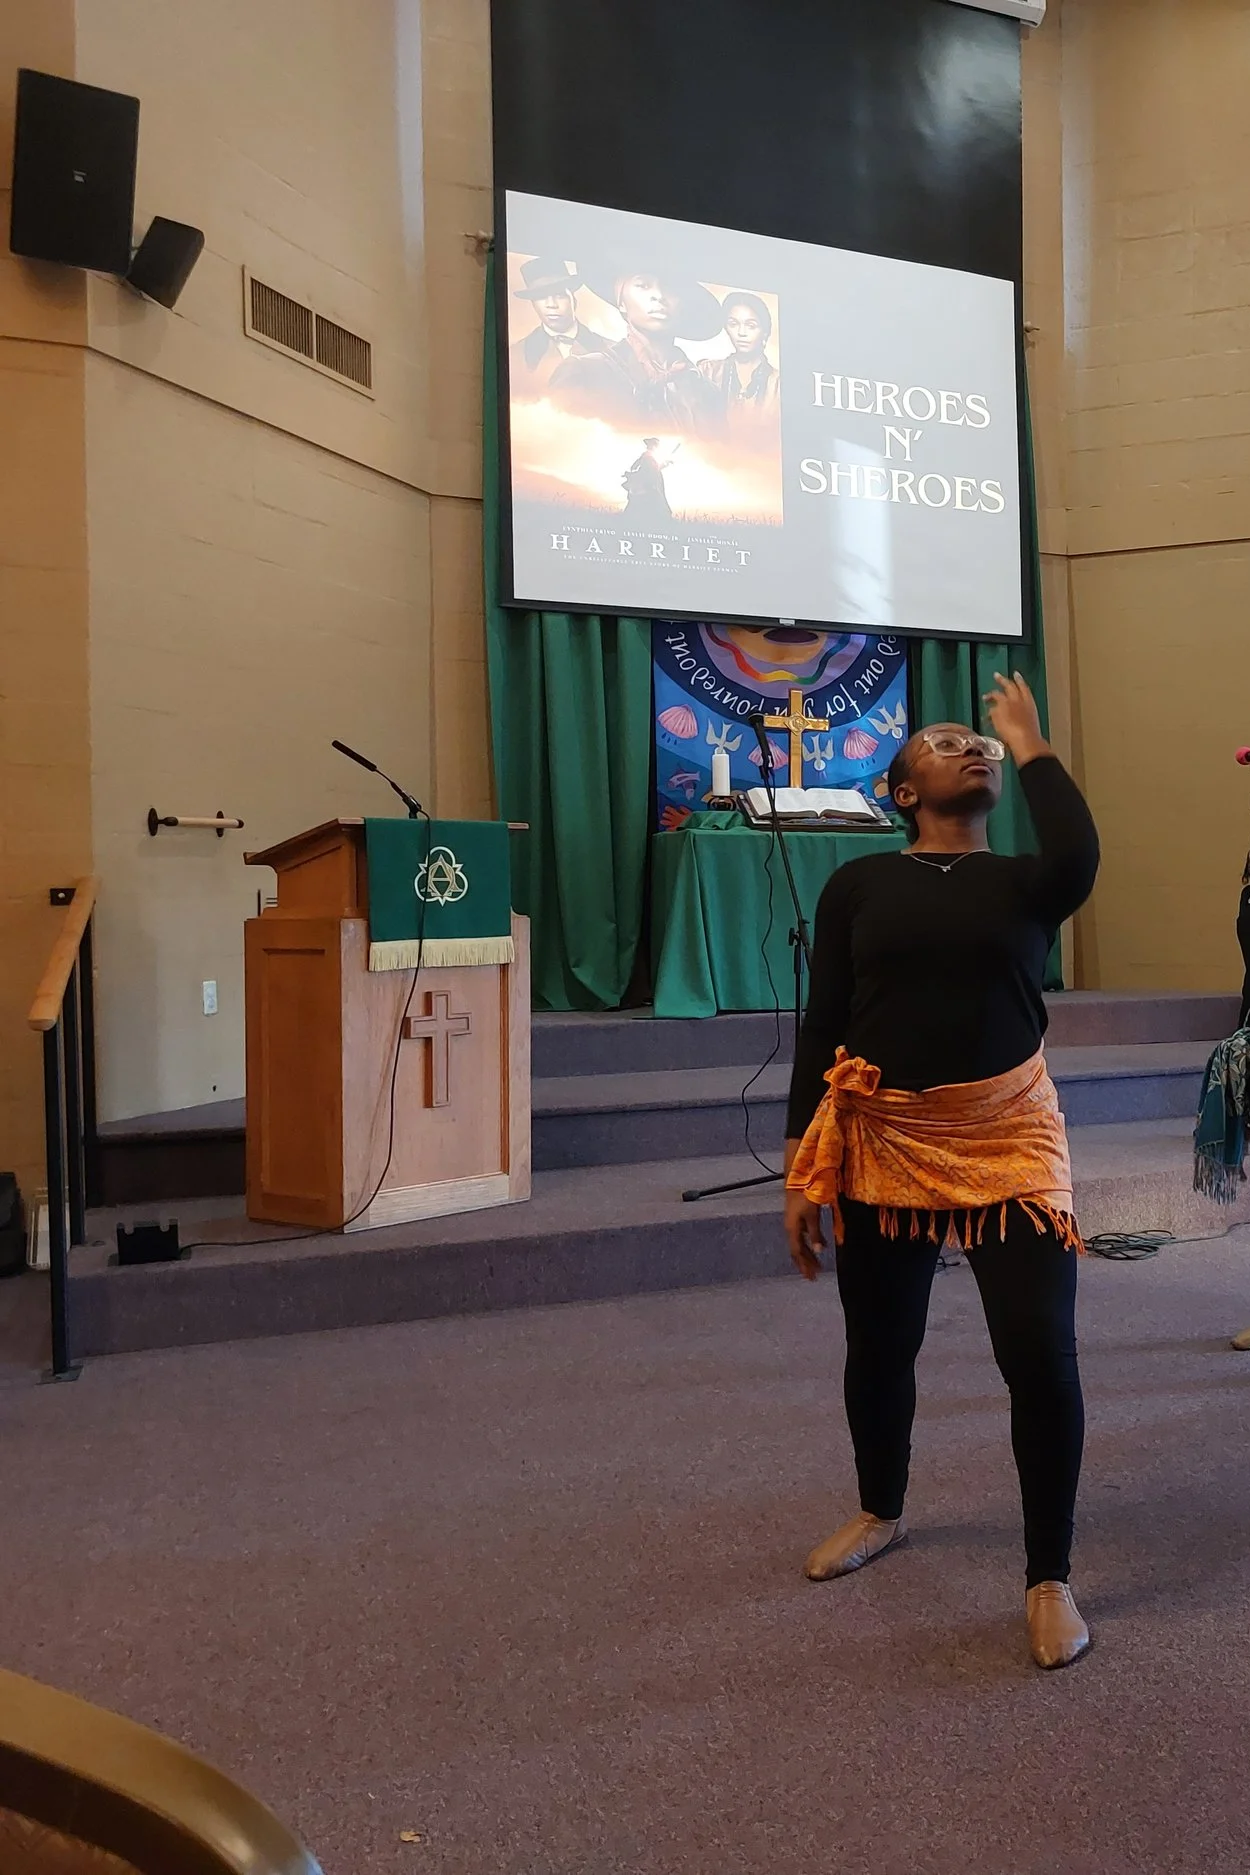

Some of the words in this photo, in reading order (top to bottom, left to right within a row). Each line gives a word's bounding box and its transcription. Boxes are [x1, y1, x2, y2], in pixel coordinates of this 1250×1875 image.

[812, 371, 991, 428] HEROES
[882, 424, 923, 462] N'
[800, 457, 1005, 514] SHEROES
[550, 533, 751, 566] HARRIET
[664, 631, 697, 671] out
[854, 658, 885, 695] out
[825, 683, 862, 718] for
